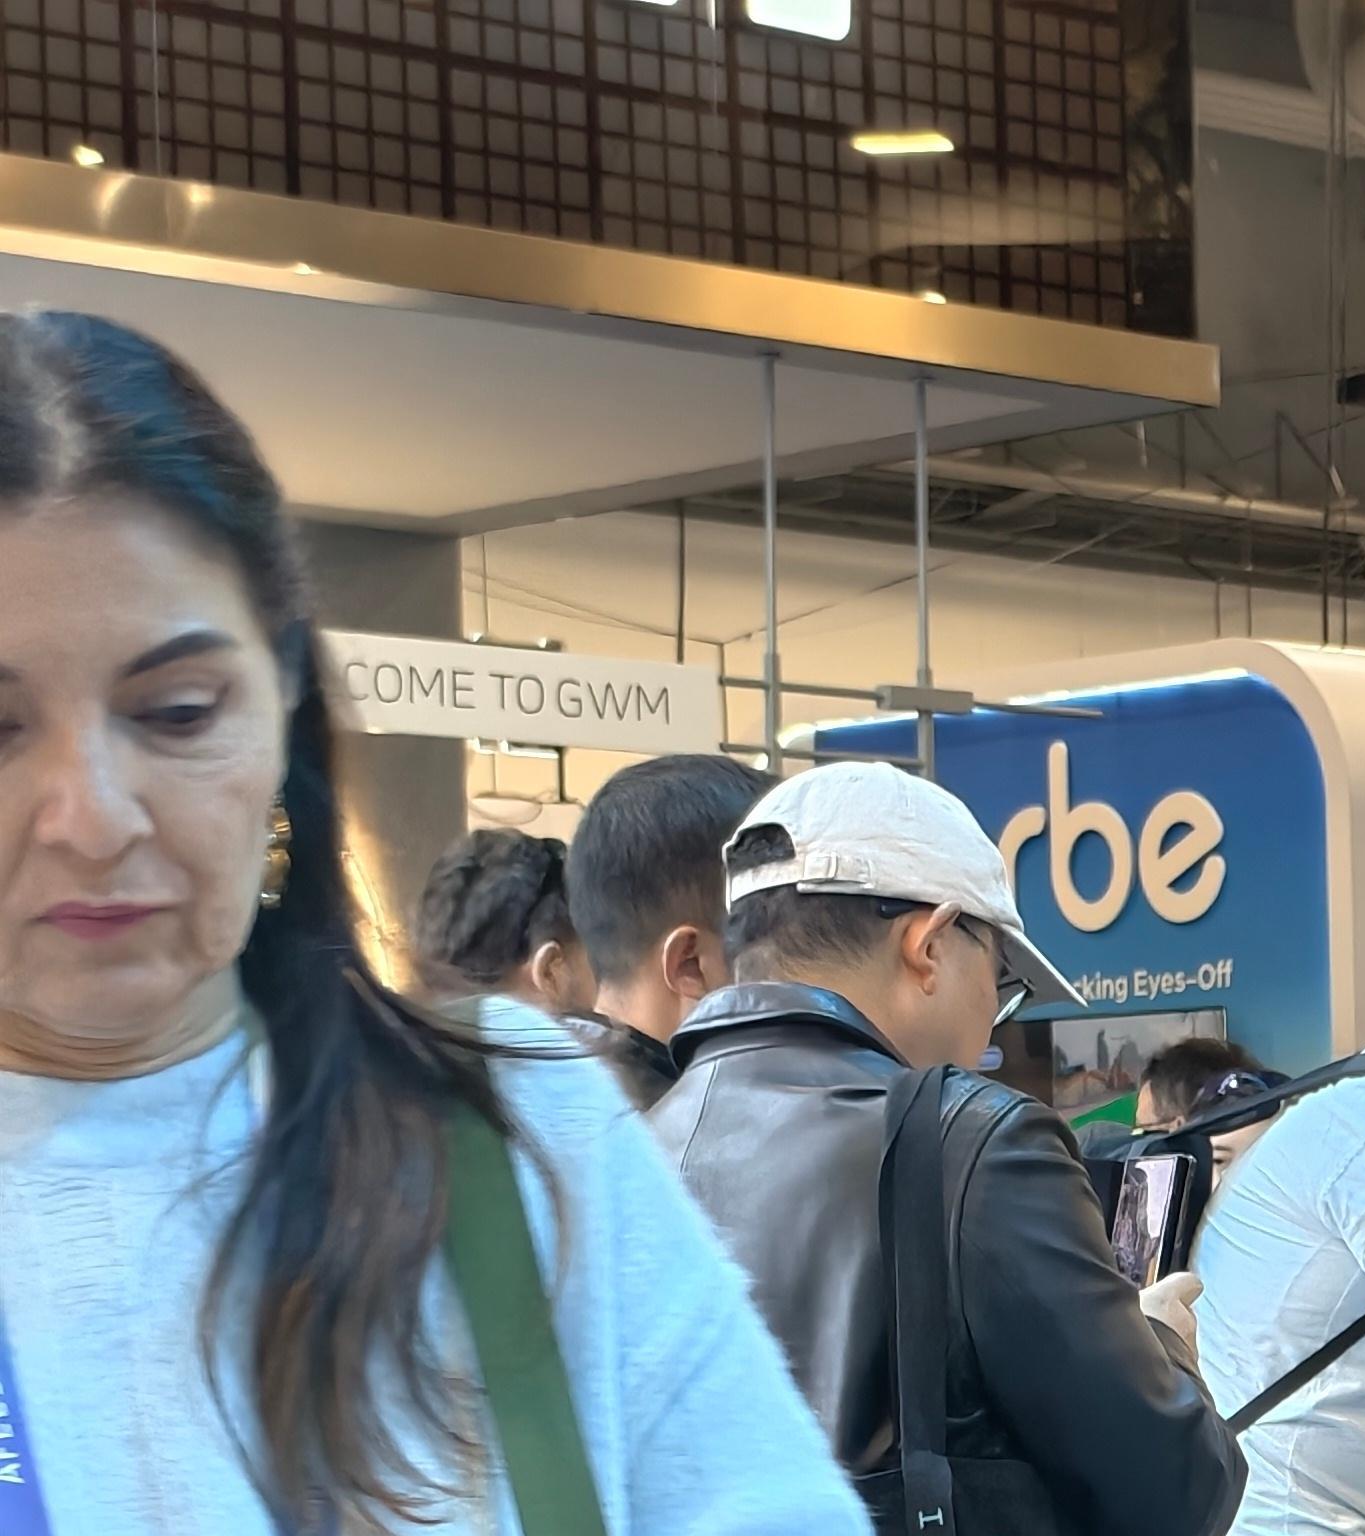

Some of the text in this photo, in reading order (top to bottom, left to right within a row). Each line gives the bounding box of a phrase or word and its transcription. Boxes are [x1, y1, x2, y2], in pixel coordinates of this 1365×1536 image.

[345, 662, 671, 725] COME TO GWM
[998, 739, 1227, 932] rbe
[1134, 959, 1234, 1000] Eyes-Off
